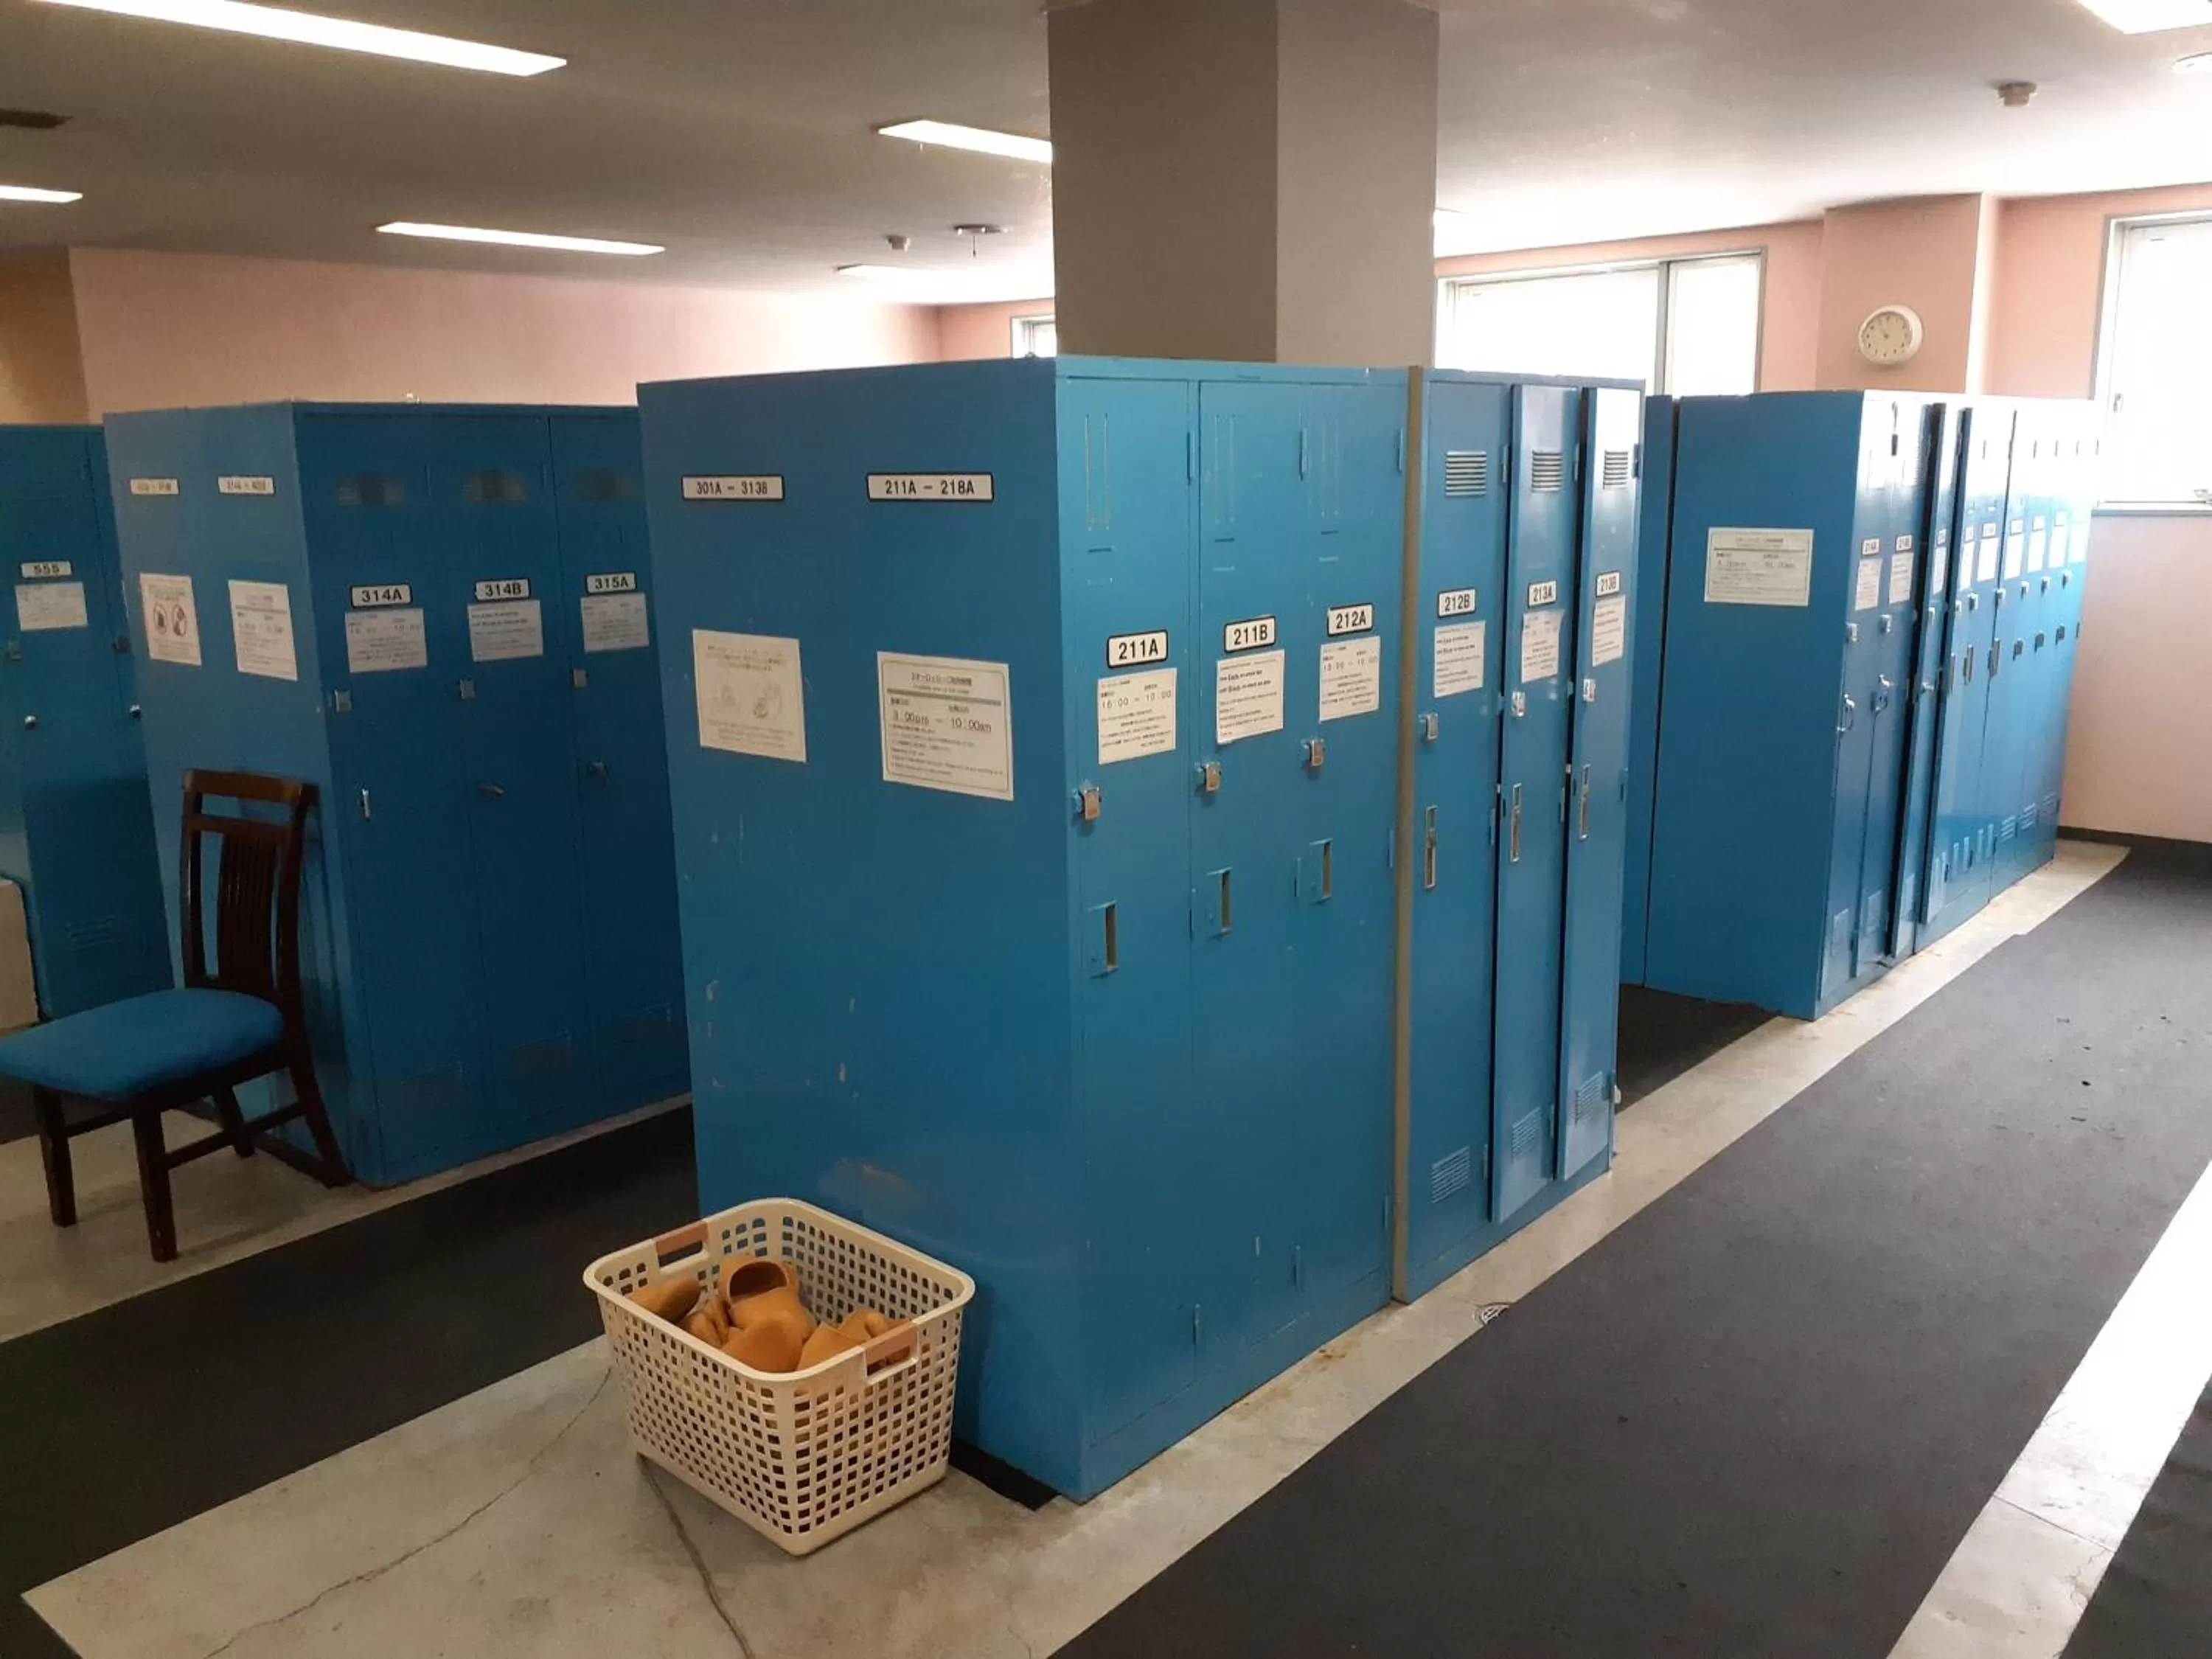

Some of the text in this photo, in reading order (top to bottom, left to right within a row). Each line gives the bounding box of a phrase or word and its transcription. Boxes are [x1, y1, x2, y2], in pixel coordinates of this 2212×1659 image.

[696, 480, 722, 495] 301A
[741, 480, 768, 495] 313B
[885, 479, 917, 495] 211A
[940, 479, 975, 495] 218A
[484, 582, 522, 597] 314B
[594, 576, 629, 590] 315A
[361, 587, 403, 603] 314A
[1533, 584, 1553, 602] 213A
[1444, 593, 1471, 612] 212B
[1335, 610, 1366, 630] 212A
[1233, 624, 1268, 646] 211B
[1118, 638, 1159, 661] 211A
